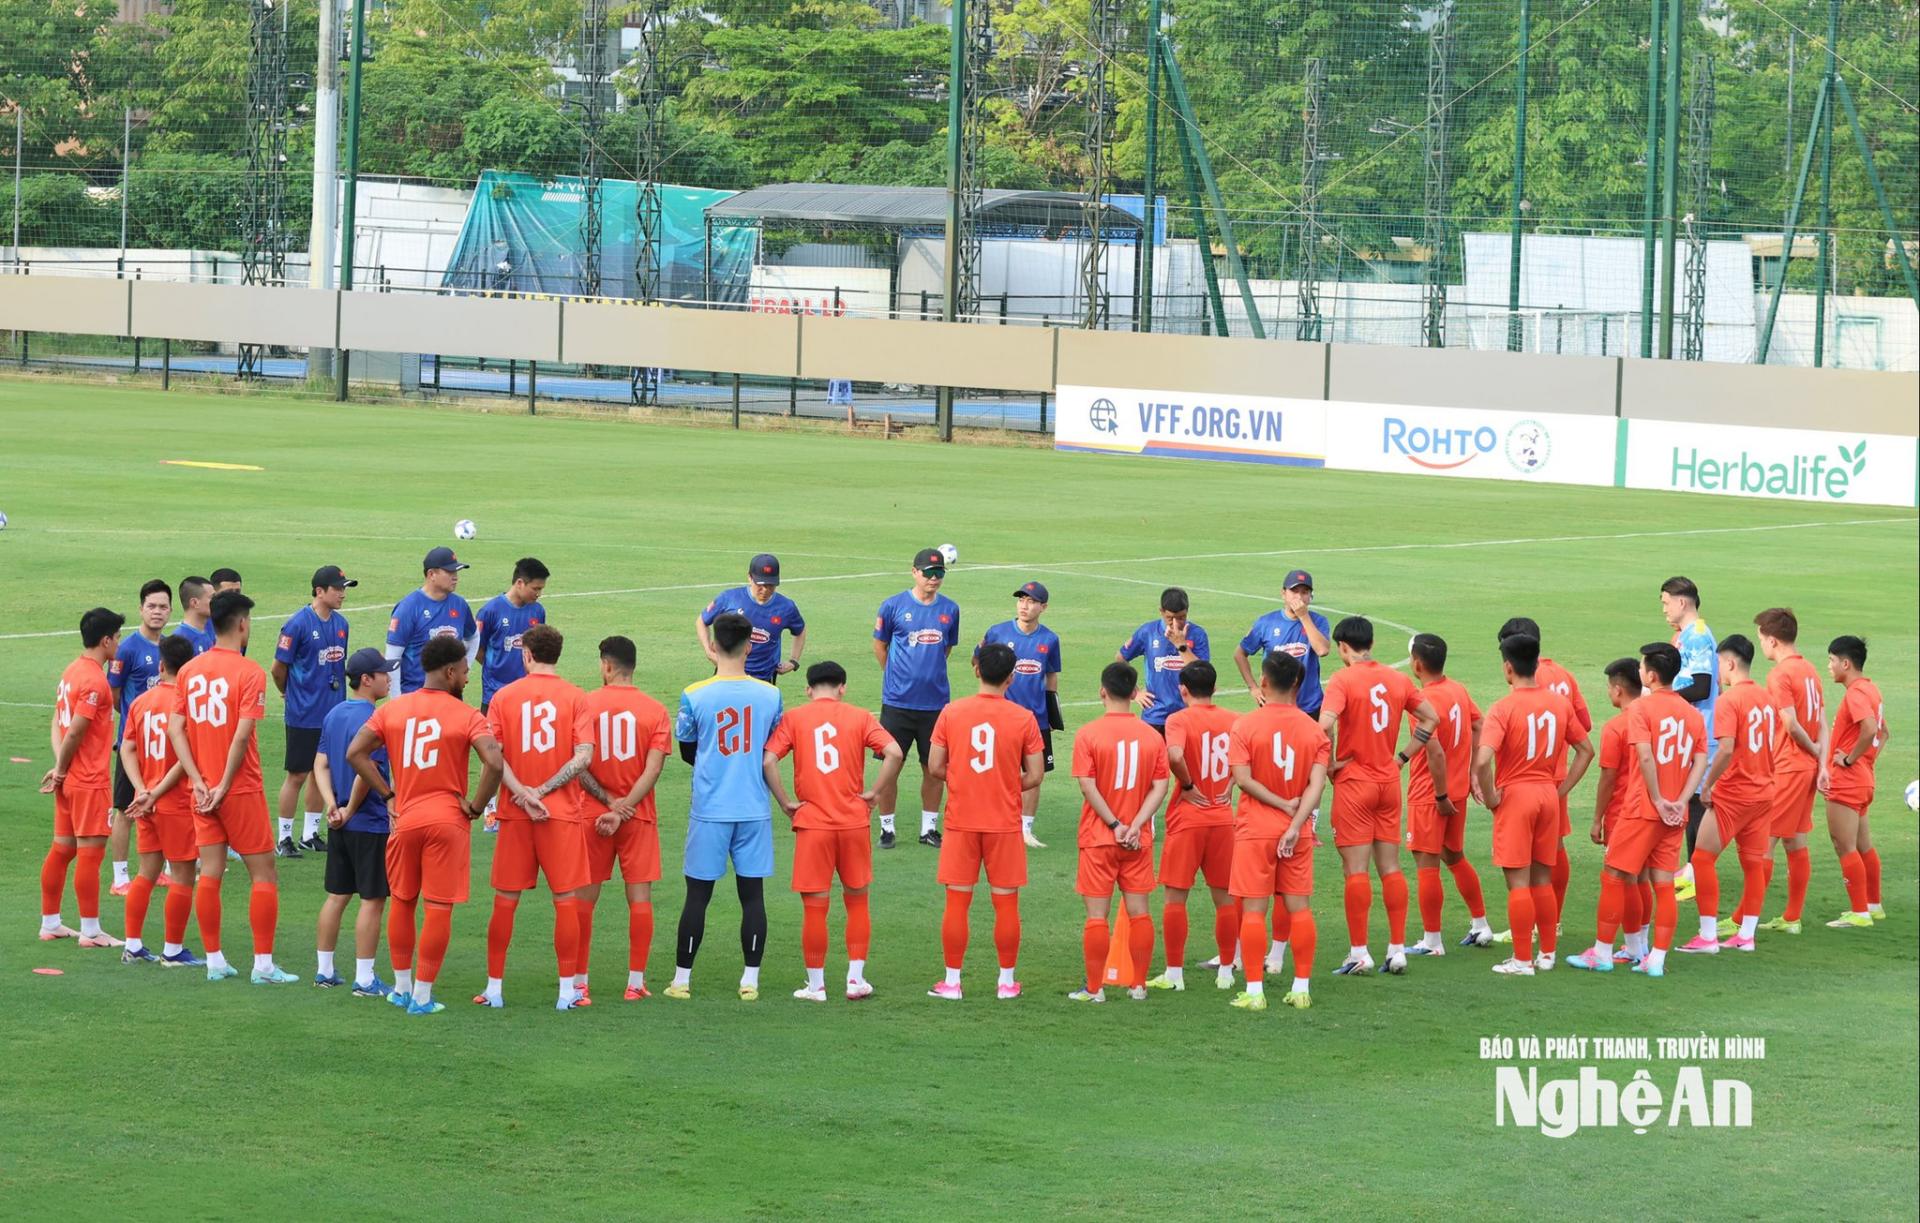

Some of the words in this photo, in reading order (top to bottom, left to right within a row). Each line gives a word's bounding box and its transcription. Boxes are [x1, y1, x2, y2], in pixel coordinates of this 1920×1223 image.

[1138, 402, 1282, 442] VFF.ORG.VN
[1671, 446, 1849, 499] Herbalife
[187, 674, 229, 728] 28
[521, 700, 557, 753] 13
[1369, 683, 1389, 734] 5
[143, 710, 168, 761] 15
[402, 717, 442, 770] 12
[599, 710, 637, 763] 10
[716, 704, 753, 757] 21
[813, 721, 840, 775] 6
[969, 721, 996, 775] 9
[1201, 730, 1230, 783] 18
[1272, 730, 1295, 782] 4
[1526, 709, 1557, 761] 17
[1656, 716, 1694, 769] 24
[1114, 739, 1139, 791] 11
